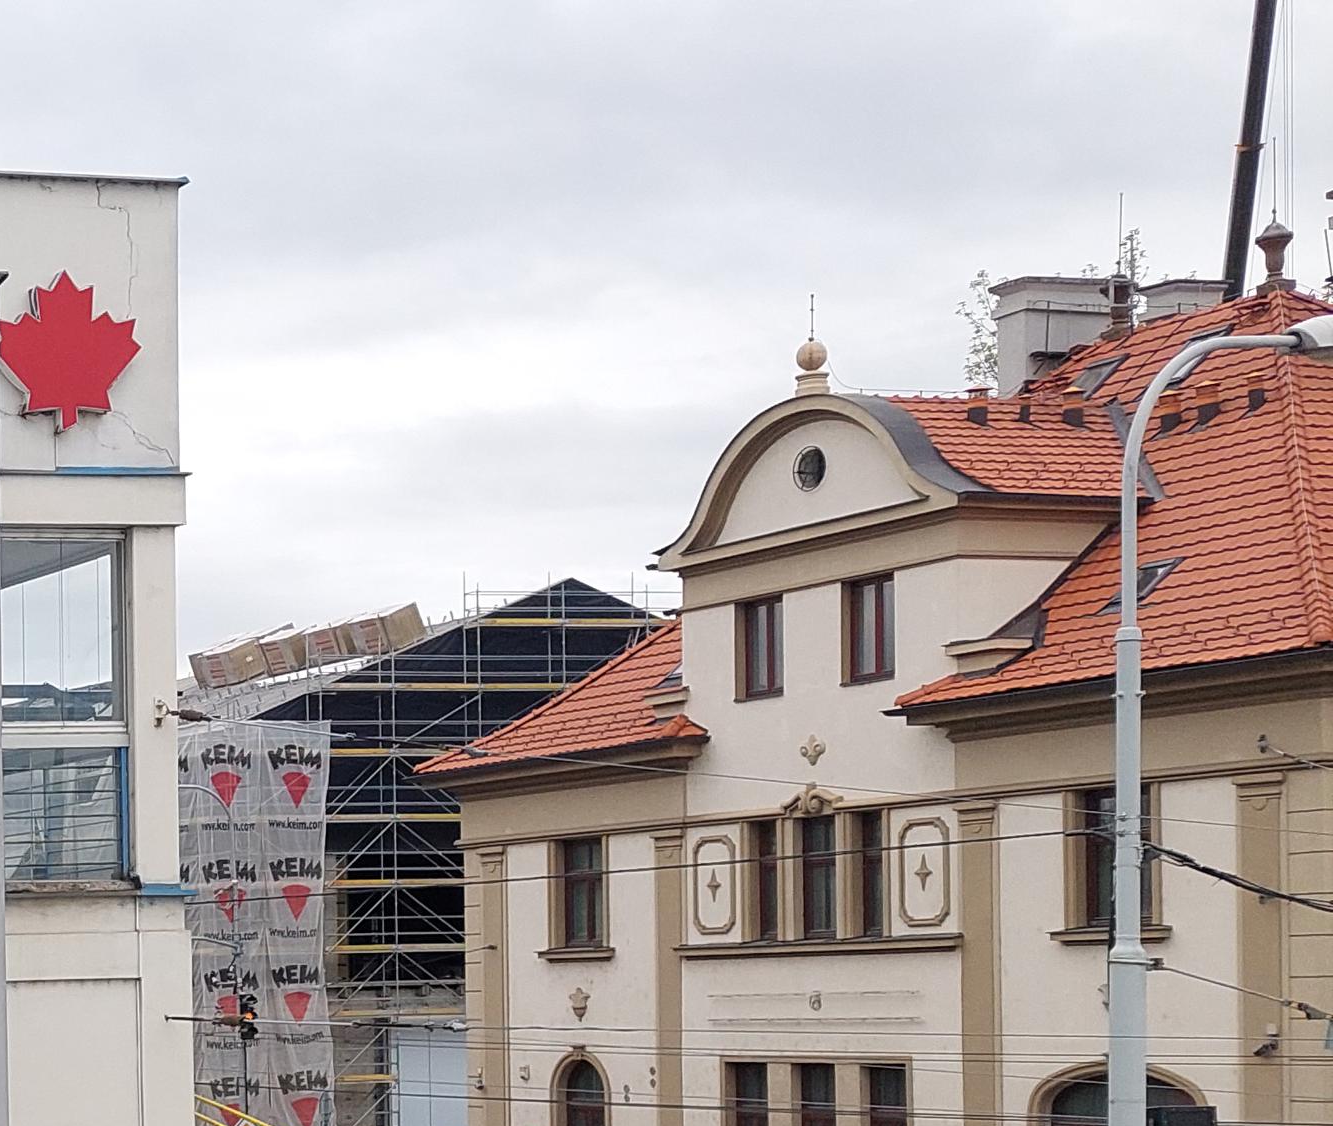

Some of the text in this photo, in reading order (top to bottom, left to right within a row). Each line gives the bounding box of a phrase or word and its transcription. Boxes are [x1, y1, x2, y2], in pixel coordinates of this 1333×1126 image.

[201, 743, 252, 770] KEIM
[267, 744, 322, 770] KEIM
[202, 859, 257, 883] KEIM
[269, 857, 322, 881] KEIM
[272, 965, 319, 988] KEIM
[278, 1069, 328, 1095] KEIM
